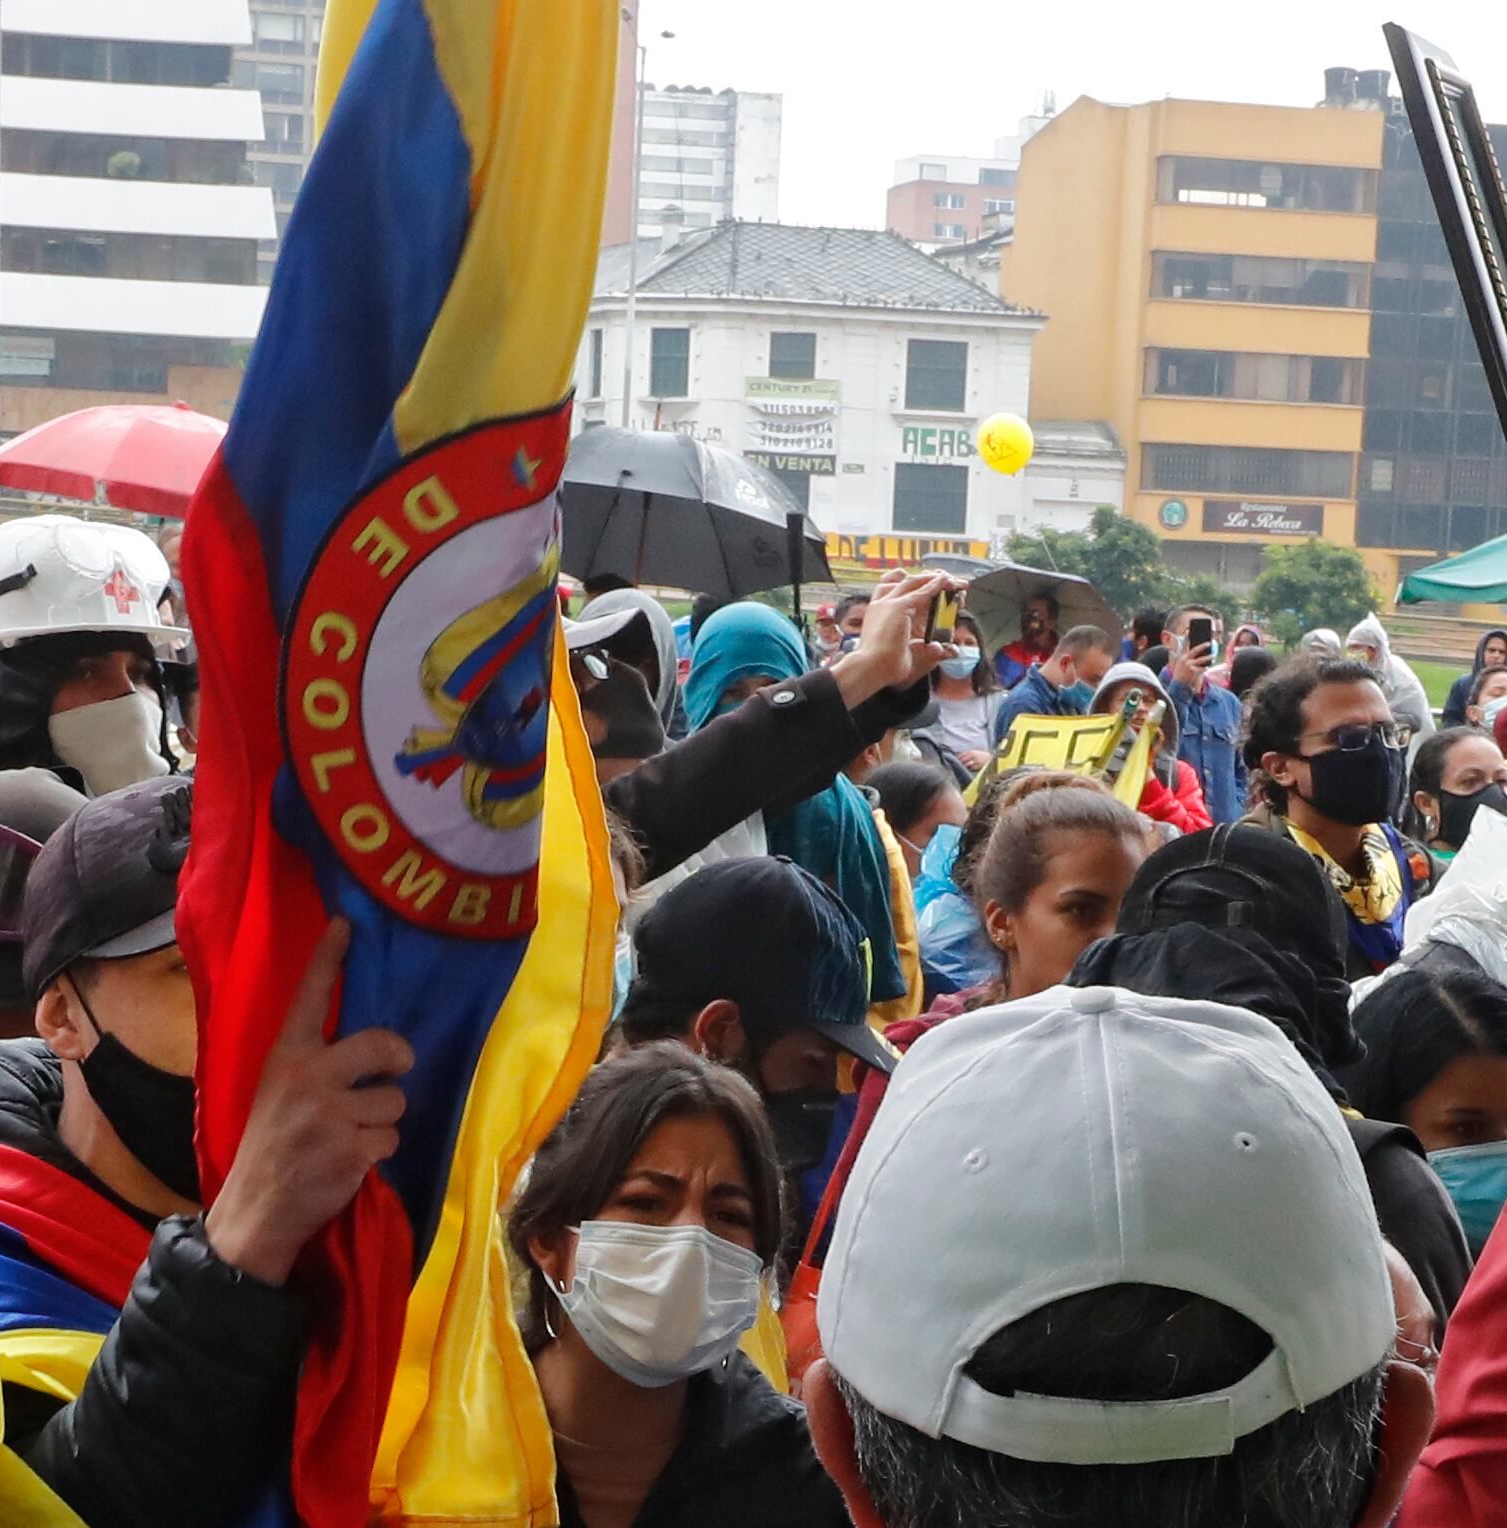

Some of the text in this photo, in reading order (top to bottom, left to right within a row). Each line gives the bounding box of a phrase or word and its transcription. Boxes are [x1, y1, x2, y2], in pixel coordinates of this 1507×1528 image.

[750, 382, 799, 393] CENTURY
[903, 427, 976, 457] ACAB
[773, 455, 833, 472] VENTA
[1224, 512, 1249, 527] La
[302, 475, 537, 926] DE COLOMBI
